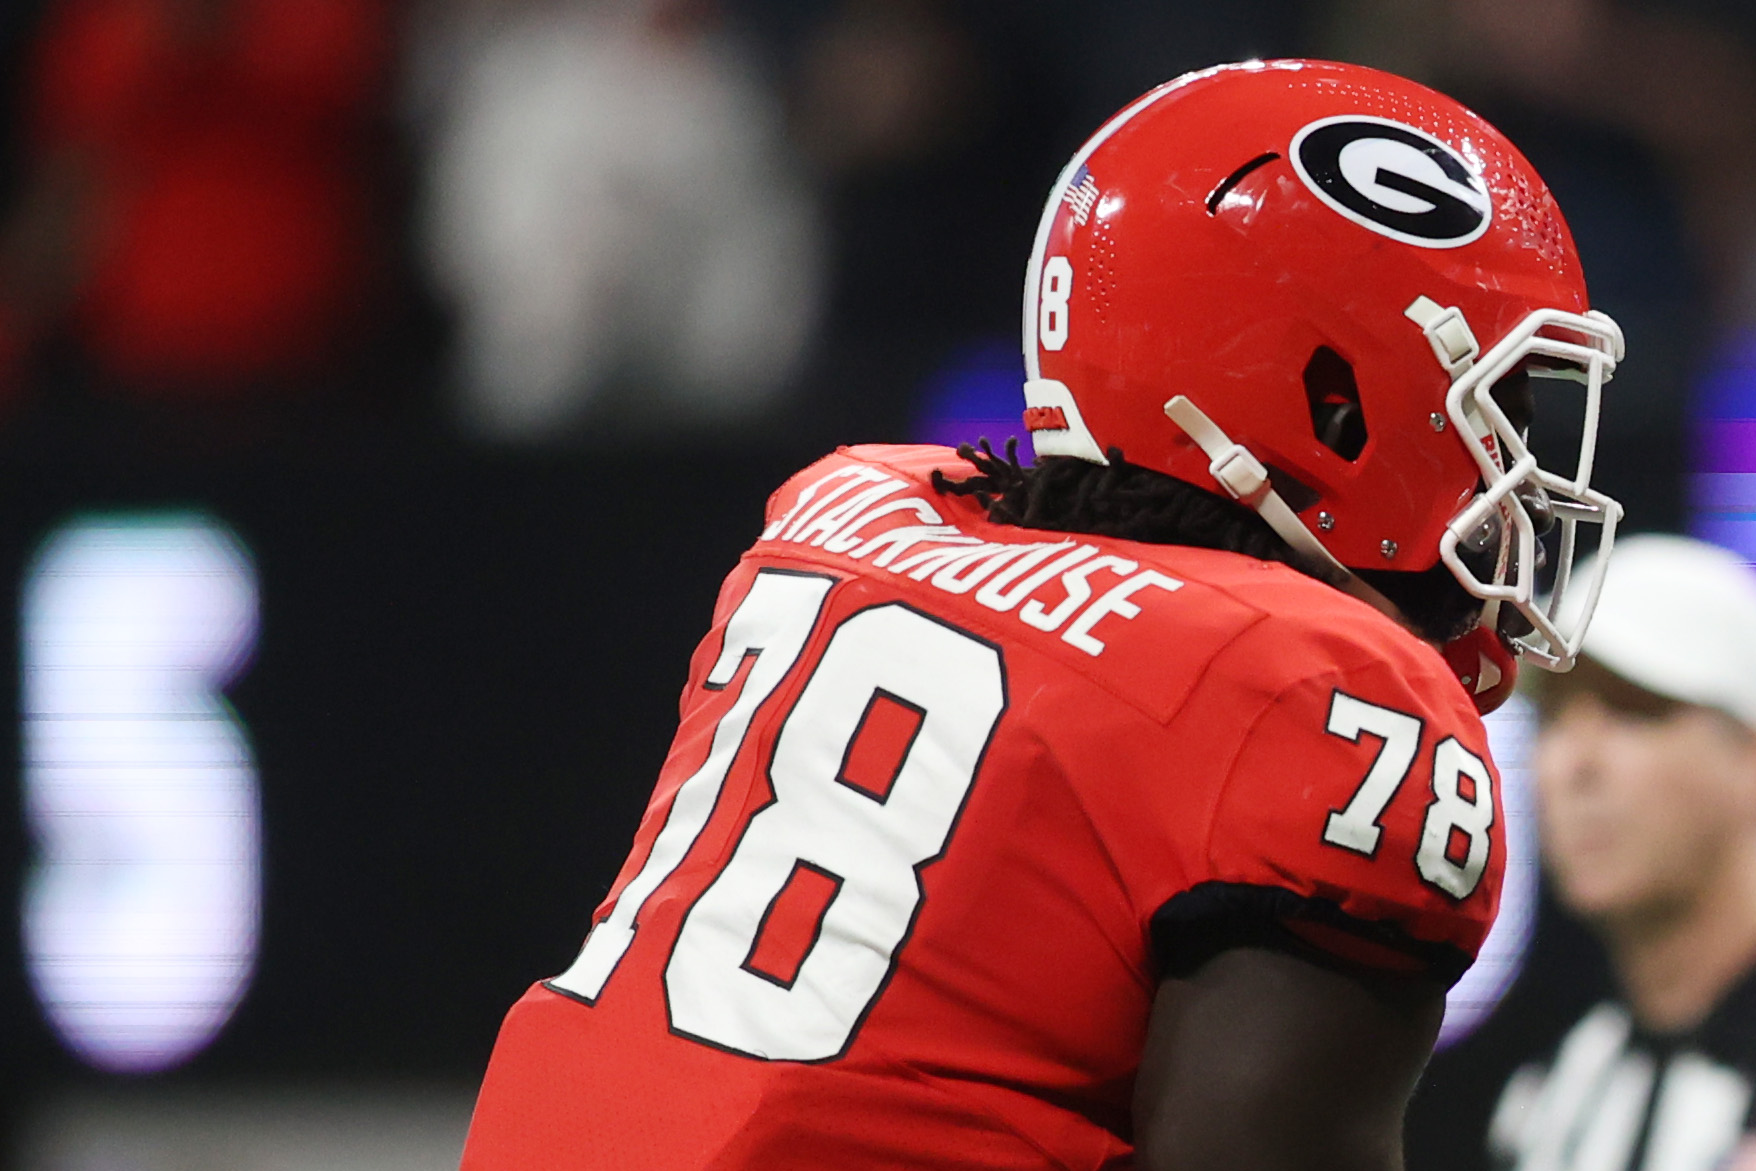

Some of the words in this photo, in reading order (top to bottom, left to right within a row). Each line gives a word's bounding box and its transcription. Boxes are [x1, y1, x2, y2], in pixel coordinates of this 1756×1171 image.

[1289, 115, 1492, 248] G
[1040, 255, 1073, 351] 8
[761, 464, 1185, 657] STACKHOUSE
[542, 568, 1010, 1063] 78
[1323, 687, 1495, 900] 78
